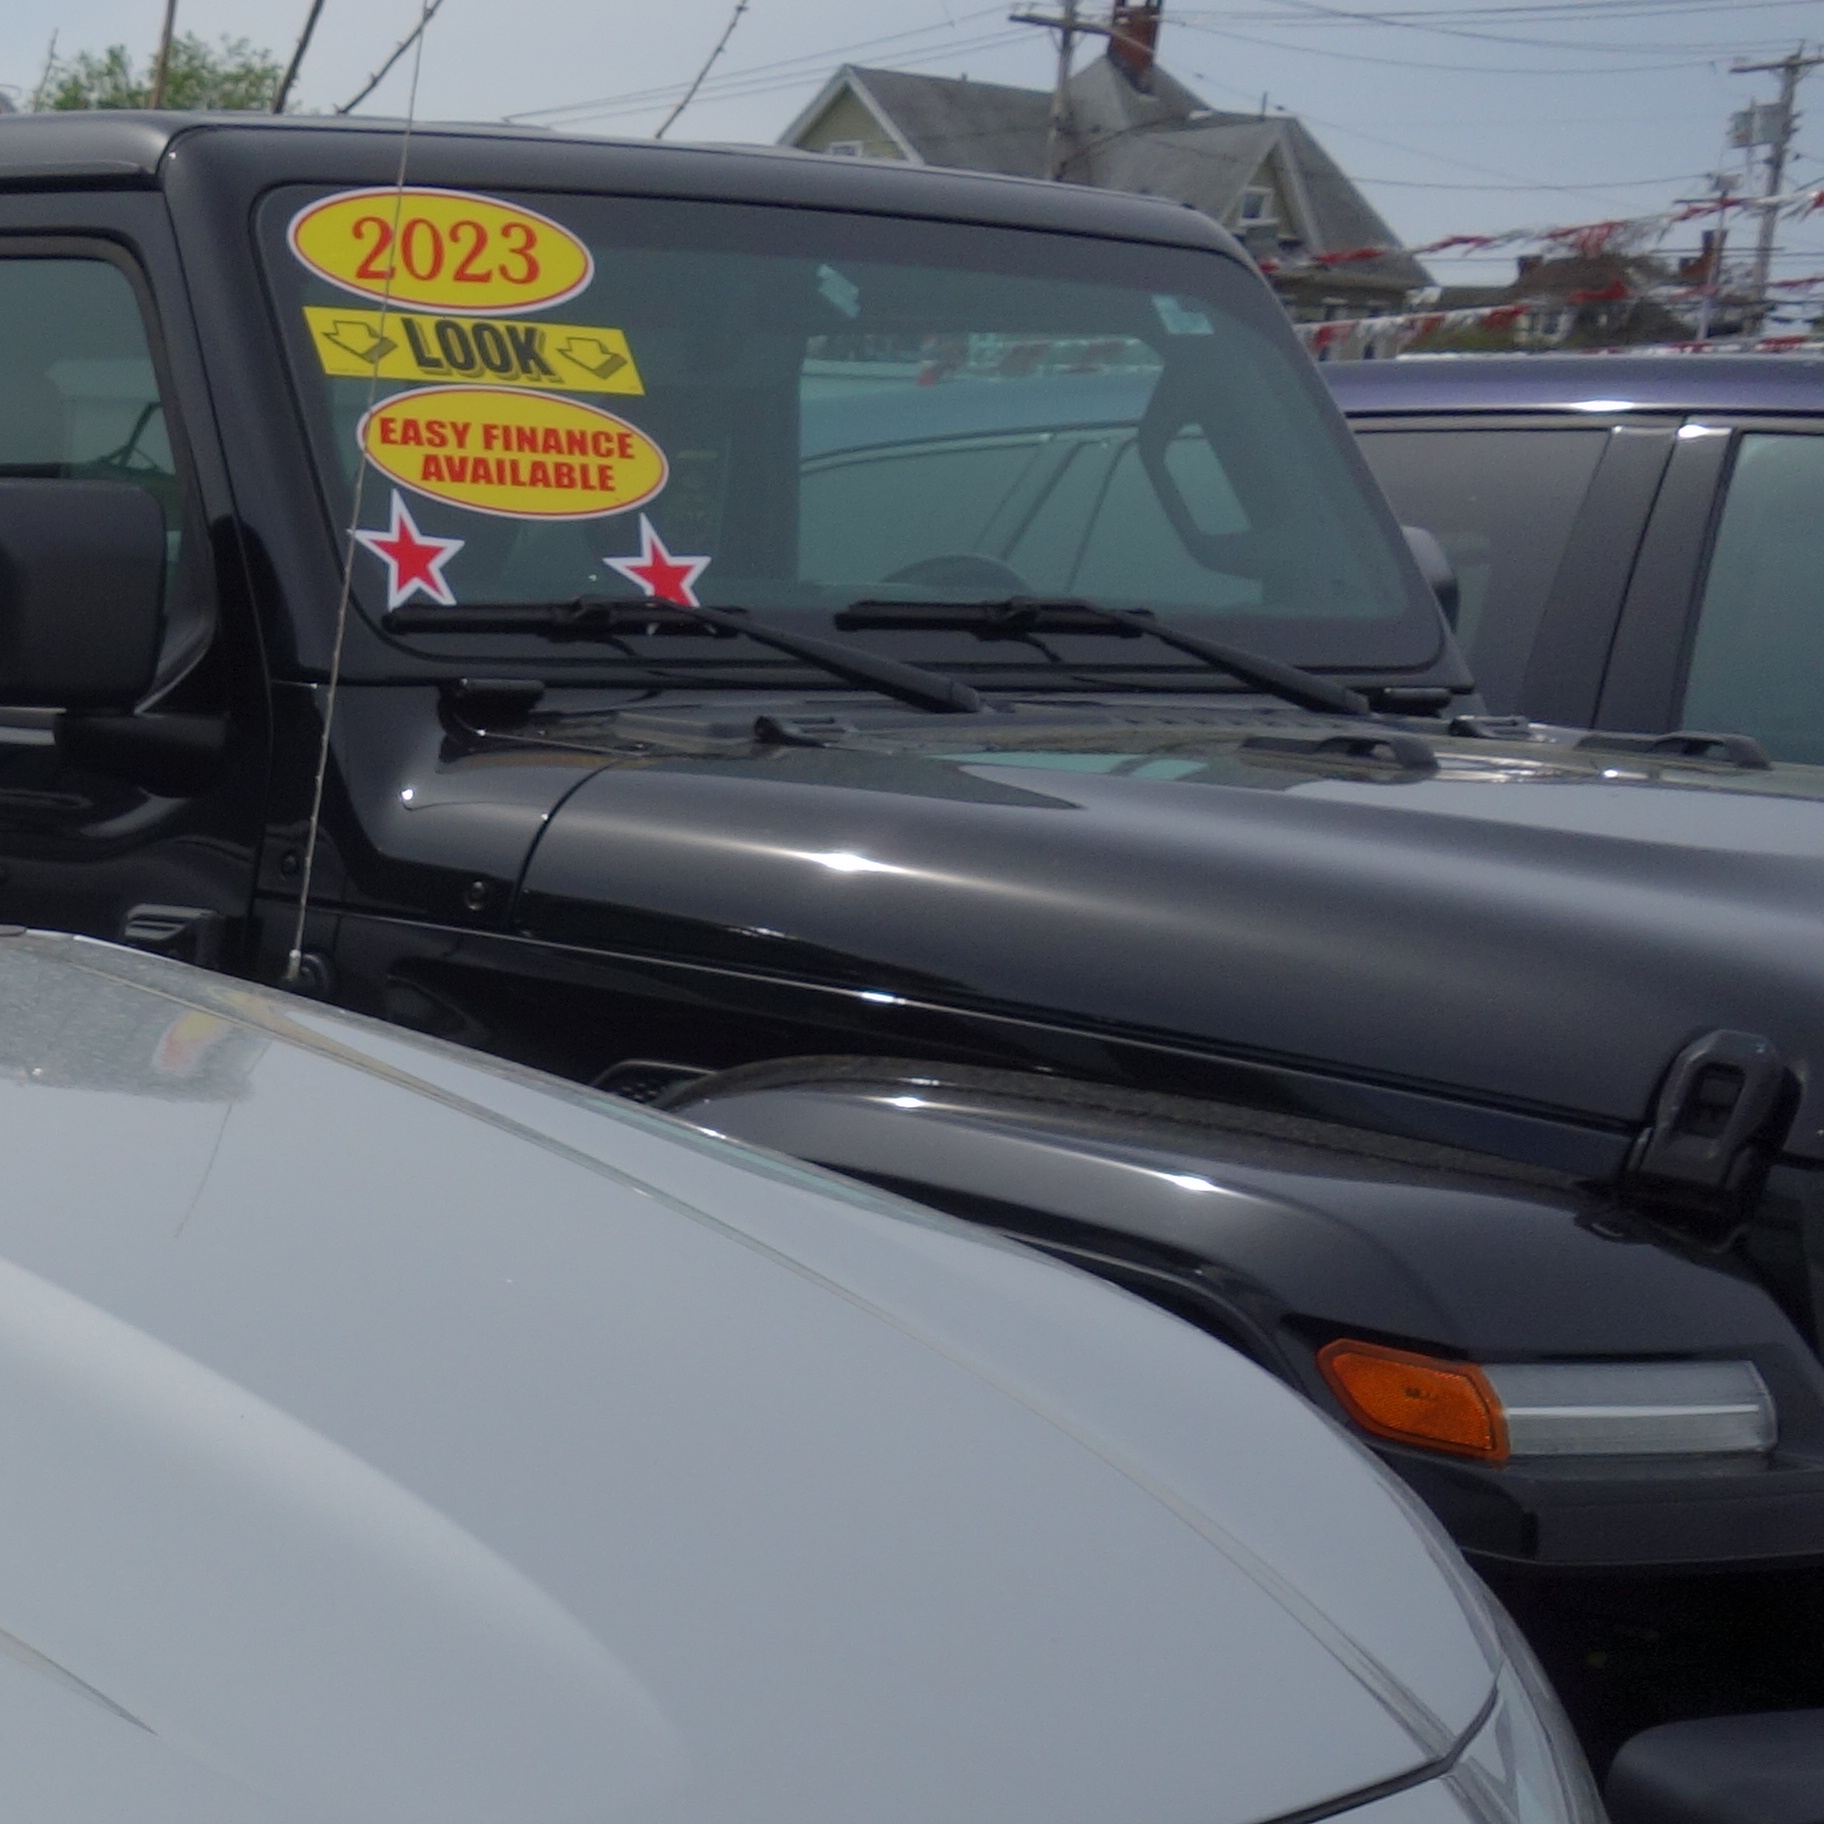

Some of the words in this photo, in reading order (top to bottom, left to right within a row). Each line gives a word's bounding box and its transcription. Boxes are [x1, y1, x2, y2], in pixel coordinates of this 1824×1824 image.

[351, 215, 541, 285] 2023
[401, 316, 558, 378] LOOK
[378, 416, 472, 449] EASY
[482, 423, 636, 460] FINANCE
[420, 453, 616, 492] AVAILABLE
